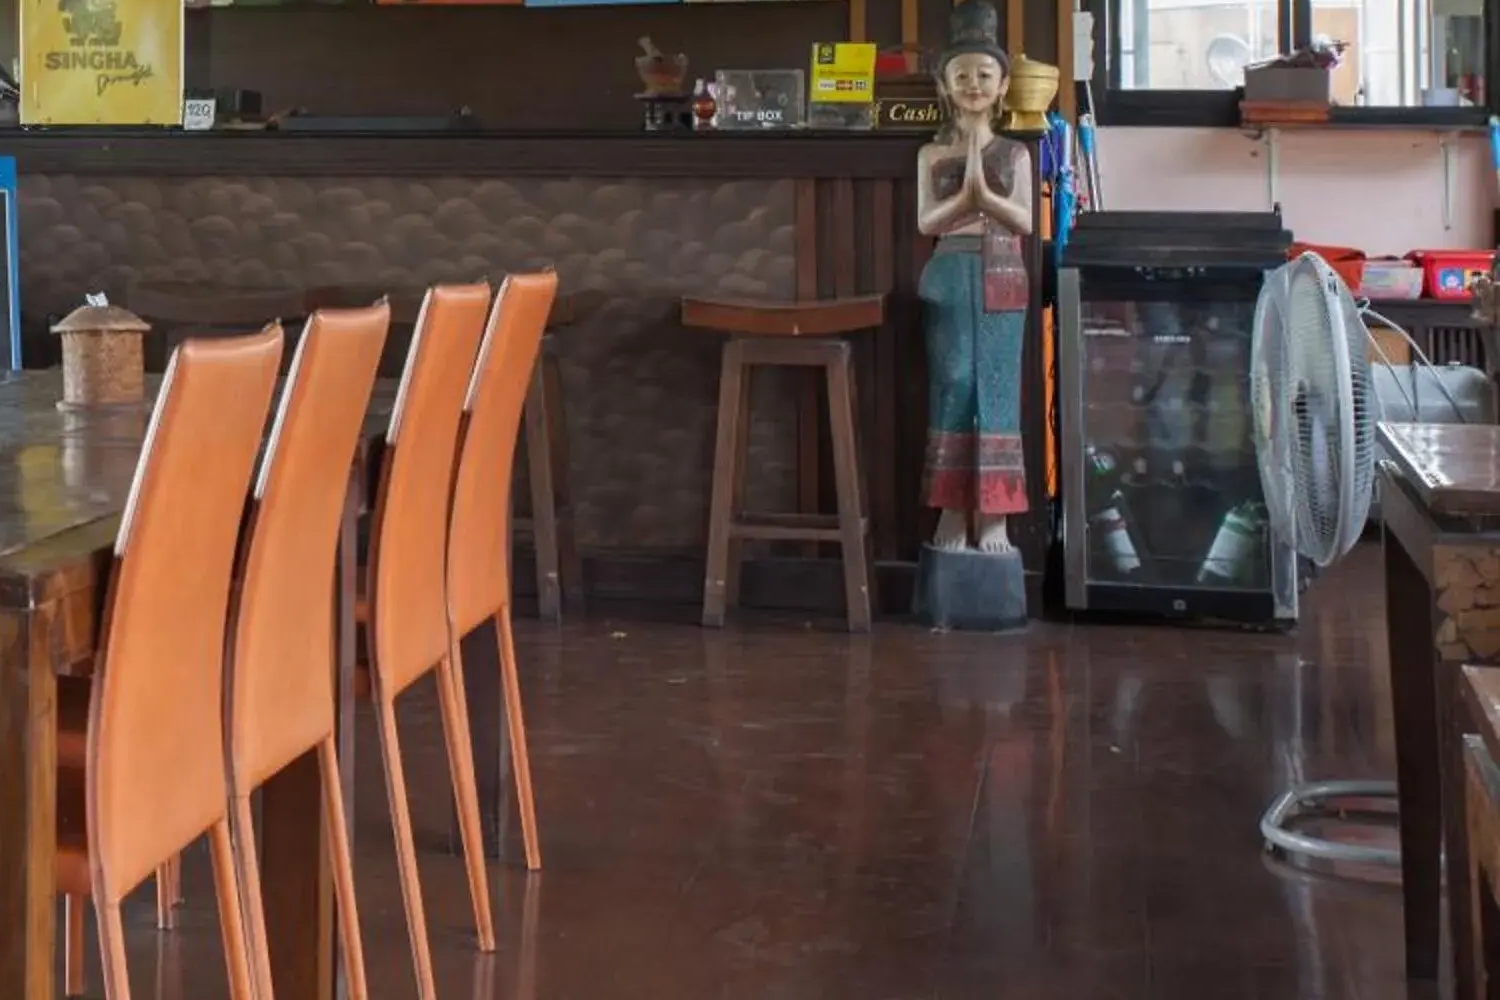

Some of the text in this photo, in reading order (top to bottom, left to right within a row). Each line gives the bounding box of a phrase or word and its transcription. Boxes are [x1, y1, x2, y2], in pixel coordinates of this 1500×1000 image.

[45, 51, 139, 70] SINGHA
[736, 110, 783, 121] TIP BOX
